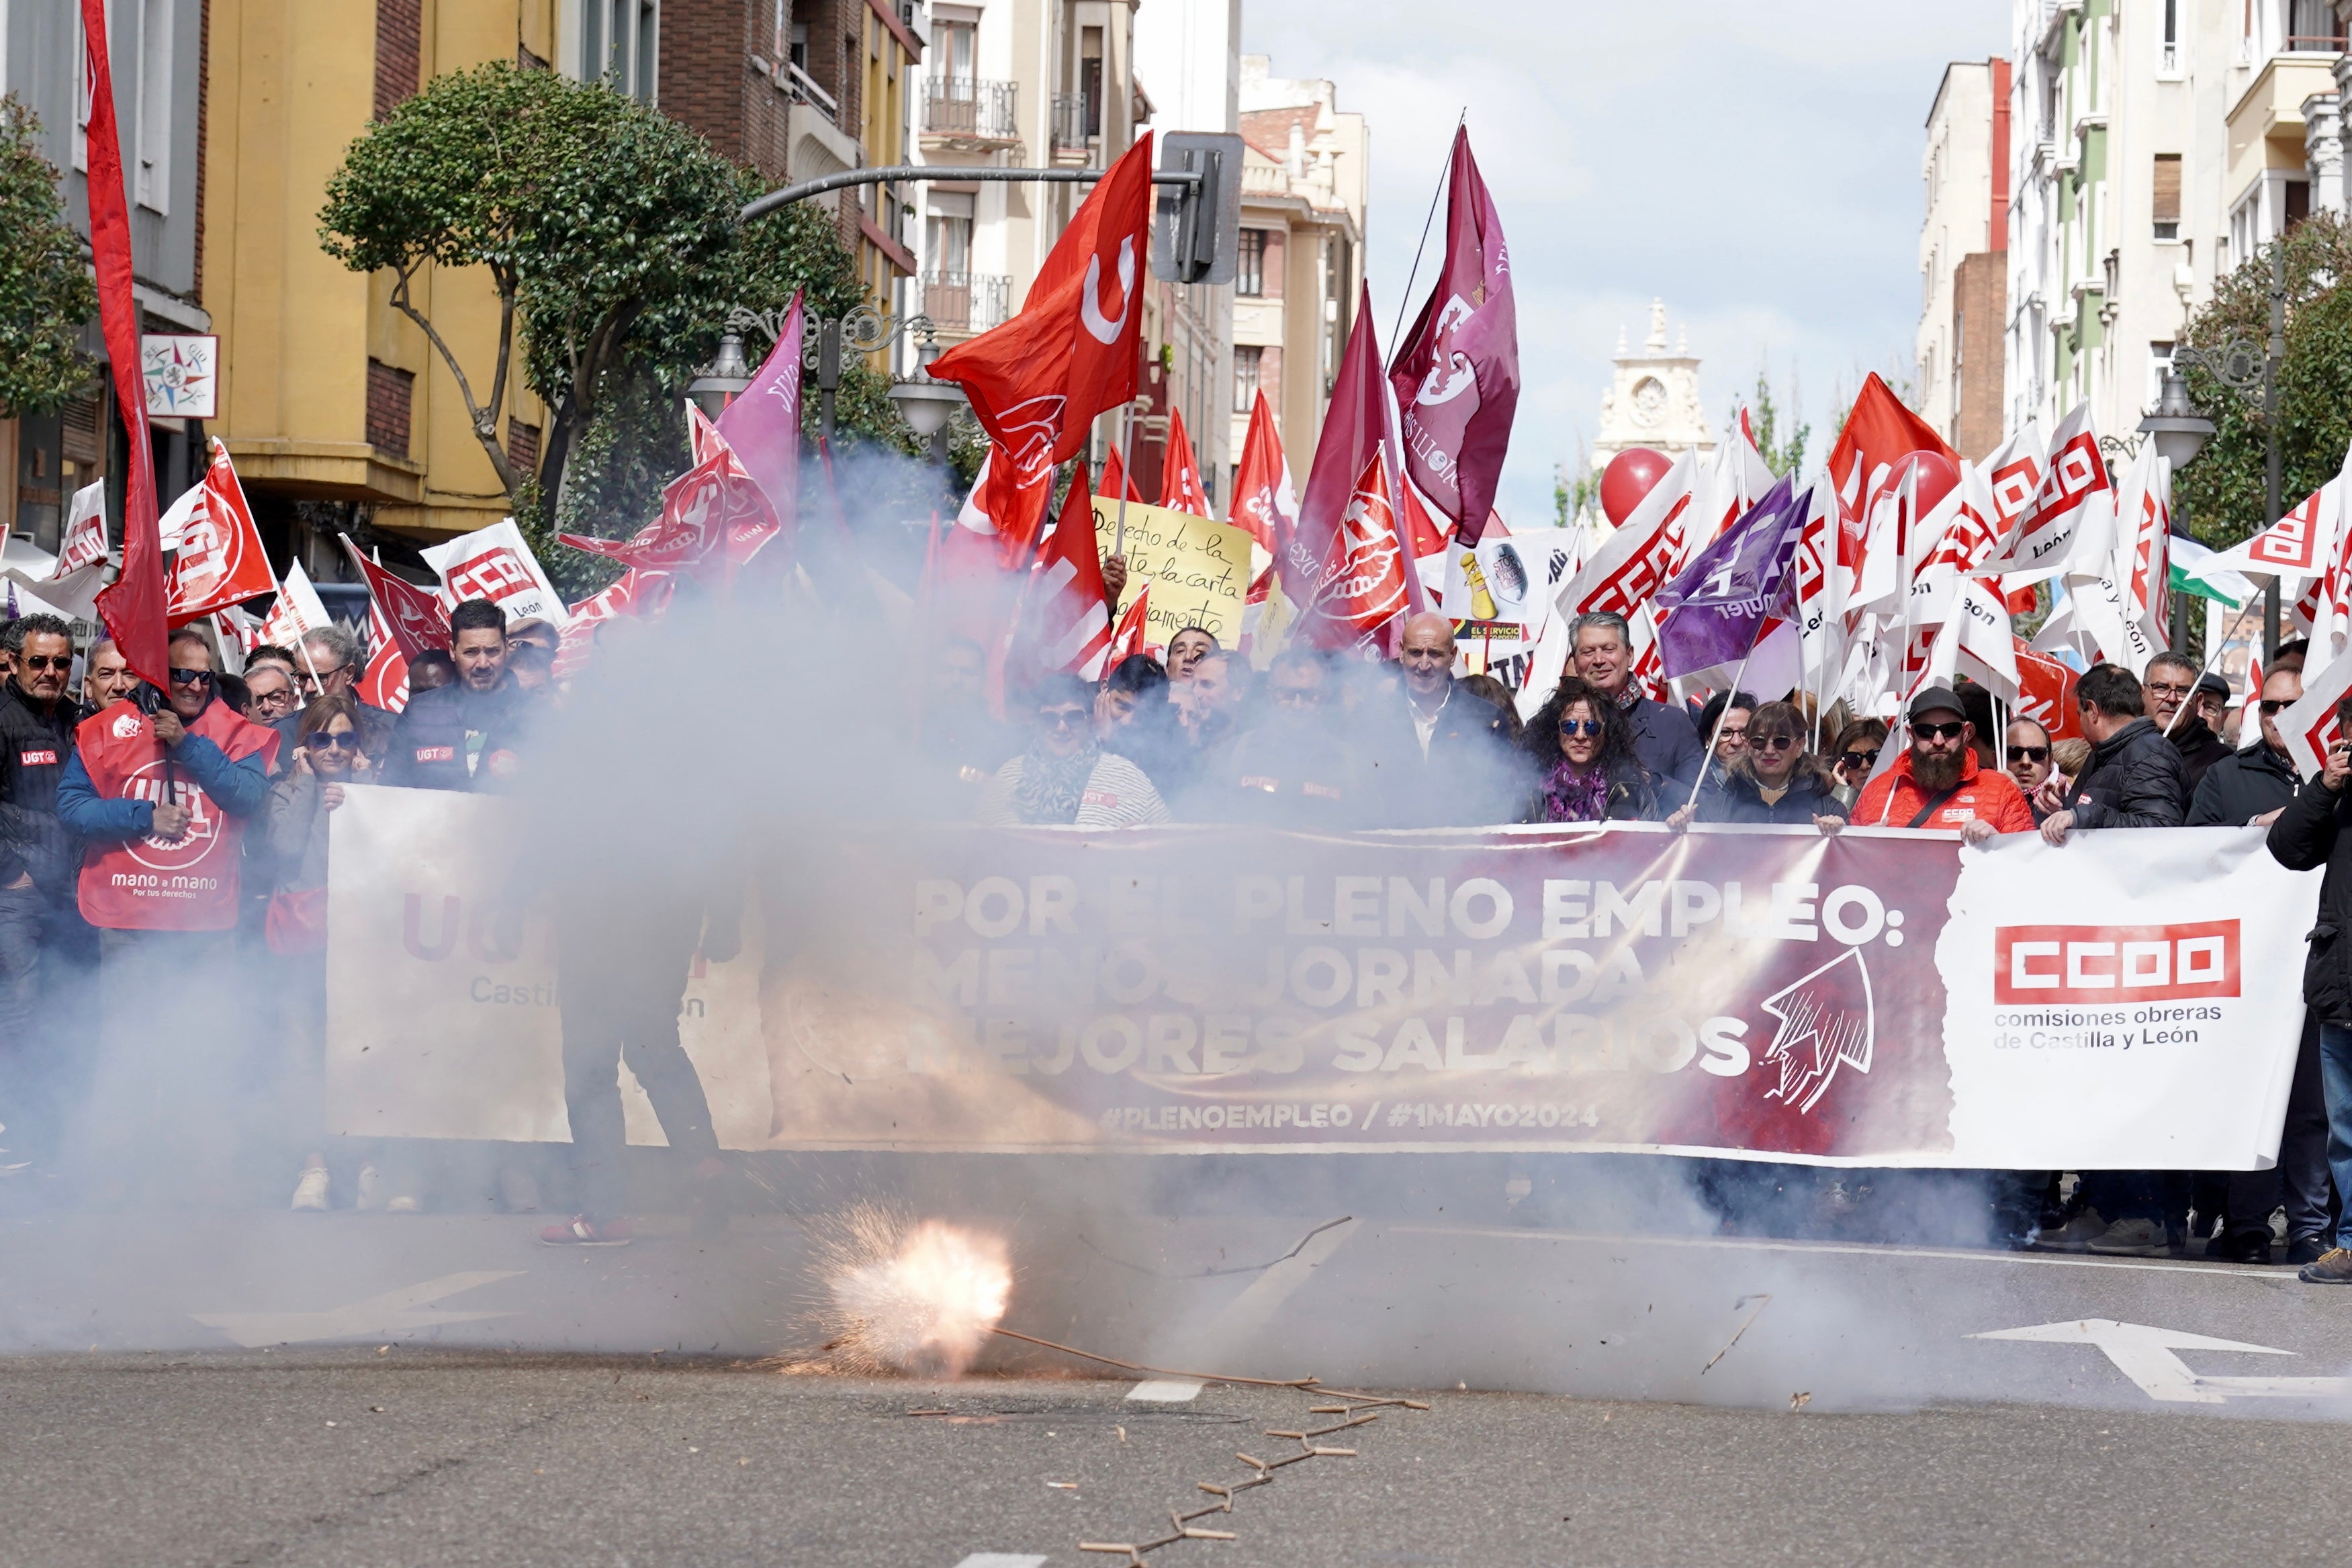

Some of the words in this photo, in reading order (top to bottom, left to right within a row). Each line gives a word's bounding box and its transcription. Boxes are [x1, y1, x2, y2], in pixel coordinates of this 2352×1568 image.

[1167, 522, 1187, 551] de
[1161, 557, 1182, 584] la
[1186, 567, 1240, 600] carta
[513, 601, 543, 618] León
[22, 751, 44, 764] UGT
[416, 748, 439, 761] UGT
[111, 874, 158, 887] mano
[172, 876, 217, 890] mano
[133, 888, 146, 897] Por
[148, 889, 159, 897] tus
[162, 889, 197, 899] derechos
[913, 875, 1079, 938] POR
[1107, 874, 1206, 936] EL
[1233, 874, 1514, 939] PLENO
[1542, 878, 1905, 948] EMPLEO:
[2011, 935, 2224, 989] CCOO
[1995, 1009, 2126, 1027] comisiones
[2134, 1006, 2222, 1025] obreras
[1330, 1013, 1751, 1077] SALARIOS
[1994, 1032, 2022, 1050] de
[2030, 1030, 2115, 1049] Castilla
[2122, 1033, 2134, 1050] y
[2142, 1026, 2199, 1045] León
[1099, 1102, 1354, 1131] #PLENOEMPLEO
[1386, 1102, 1600, 1129] #1MAYO2024
